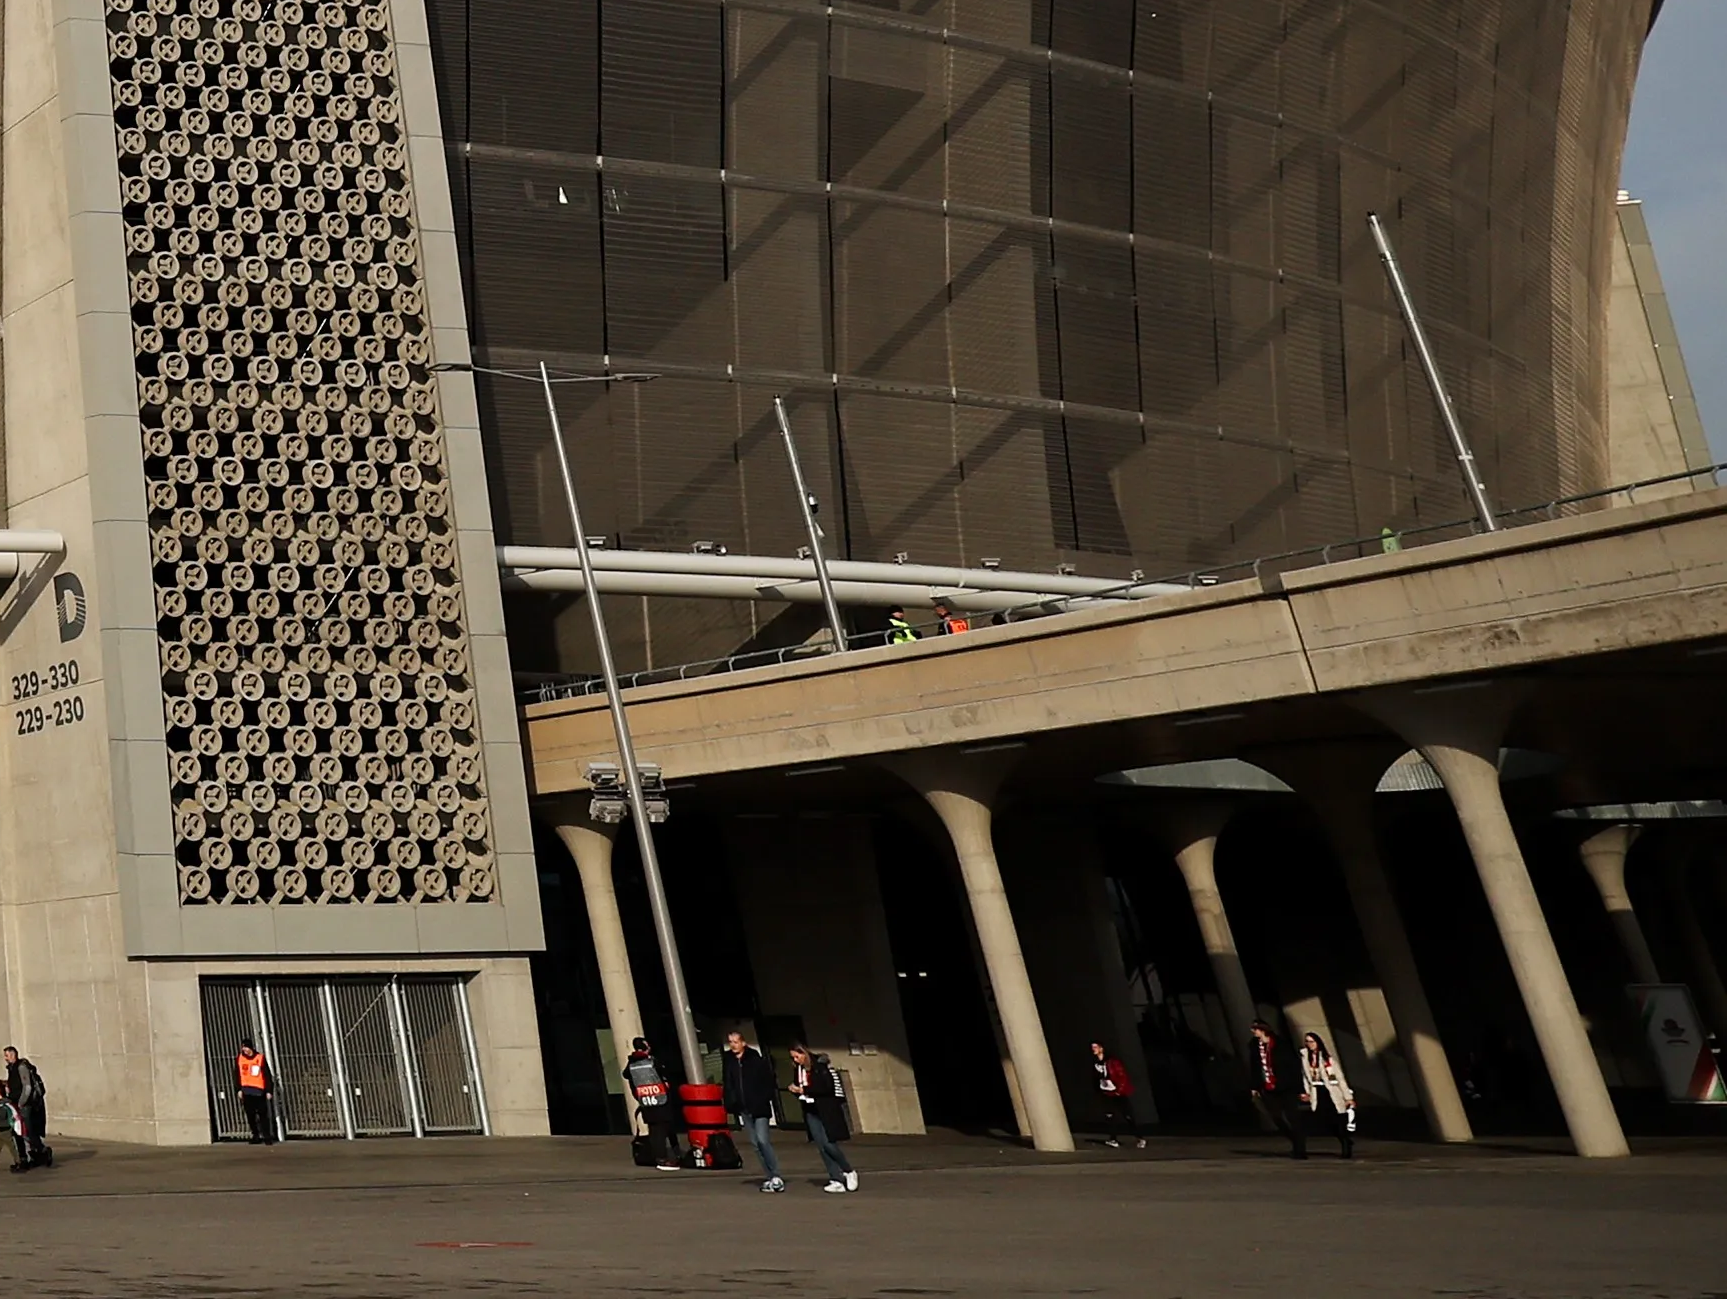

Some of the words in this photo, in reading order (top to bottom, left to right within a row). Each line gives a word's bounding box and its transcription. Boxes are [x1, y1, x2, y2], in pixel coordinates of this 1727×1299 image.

[53, 571, 86, 644] D
[12, 659, 79, 700] 329-330
[16, 695, 84, 735] 229-230
